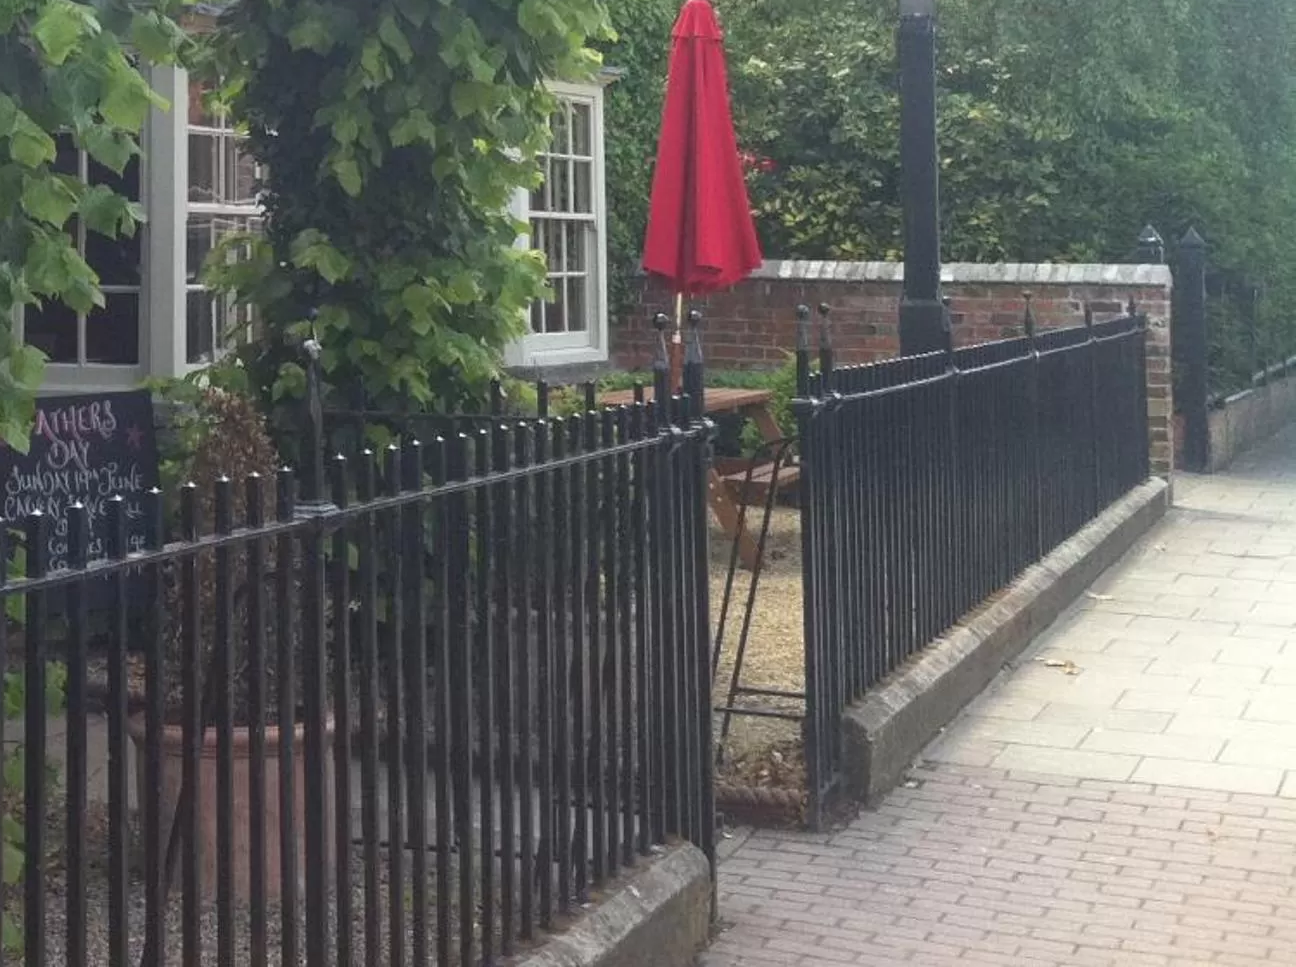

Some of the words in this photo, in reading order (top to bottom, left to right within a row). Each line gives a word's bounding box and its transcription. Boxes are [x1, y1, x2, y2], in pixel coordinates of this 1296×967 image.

[35, 399, 117, 438] ATHERS
[45, 439, 90, 472] DAY
[5, 460, 71, 495] SUNDAY
[98, 462, 144, 495] JUNE
